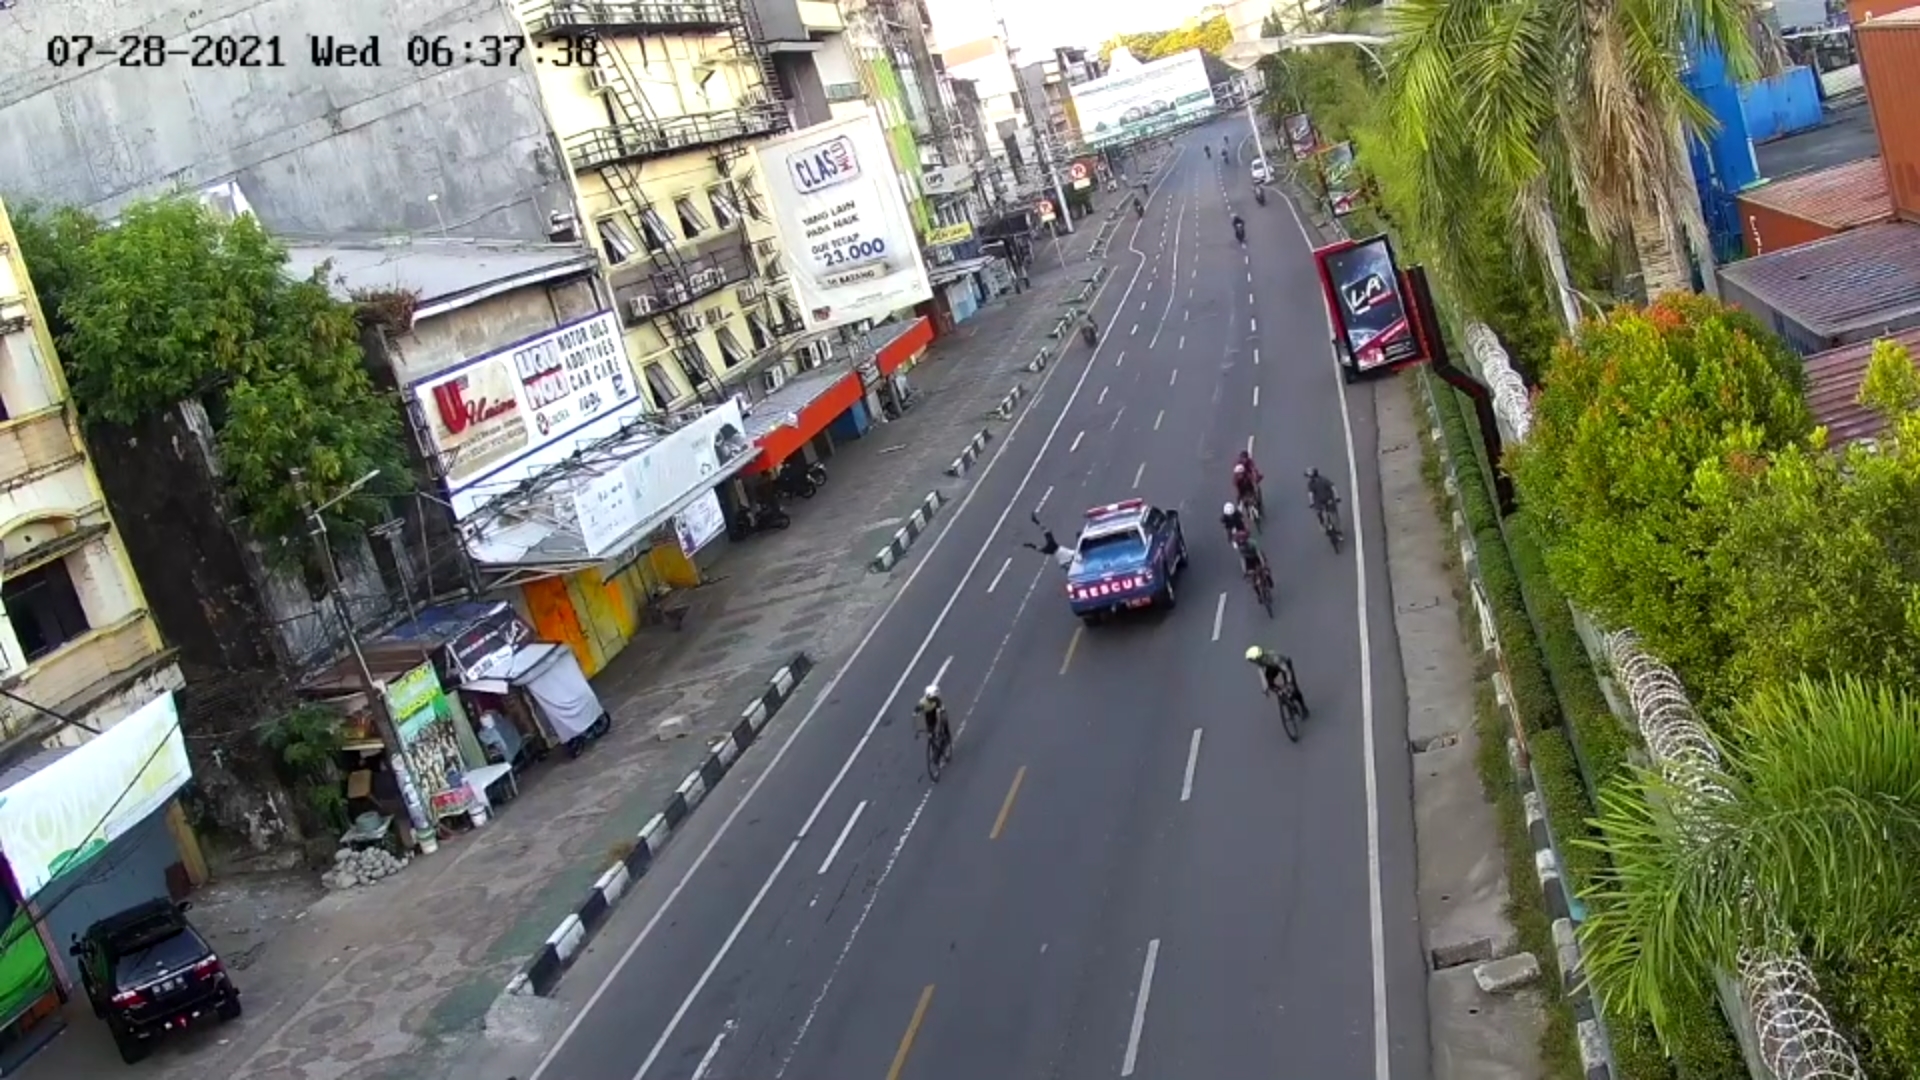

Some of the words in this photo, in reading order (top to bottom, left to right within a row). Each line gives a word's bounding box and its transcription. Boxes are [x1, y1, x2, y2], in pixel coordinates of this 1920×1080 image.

[795, 149, 838, 188] CLAS
[823, 237, 885, 267] 23.000
[556, 326, 588, 352] MOTOR
[564, 337, 615, 372] ADDITIVES
[569, 368, 593, 392] CAR
[594, 355, 621, 382] CARE
[1078, 576, 1146, 600] RESCUE
